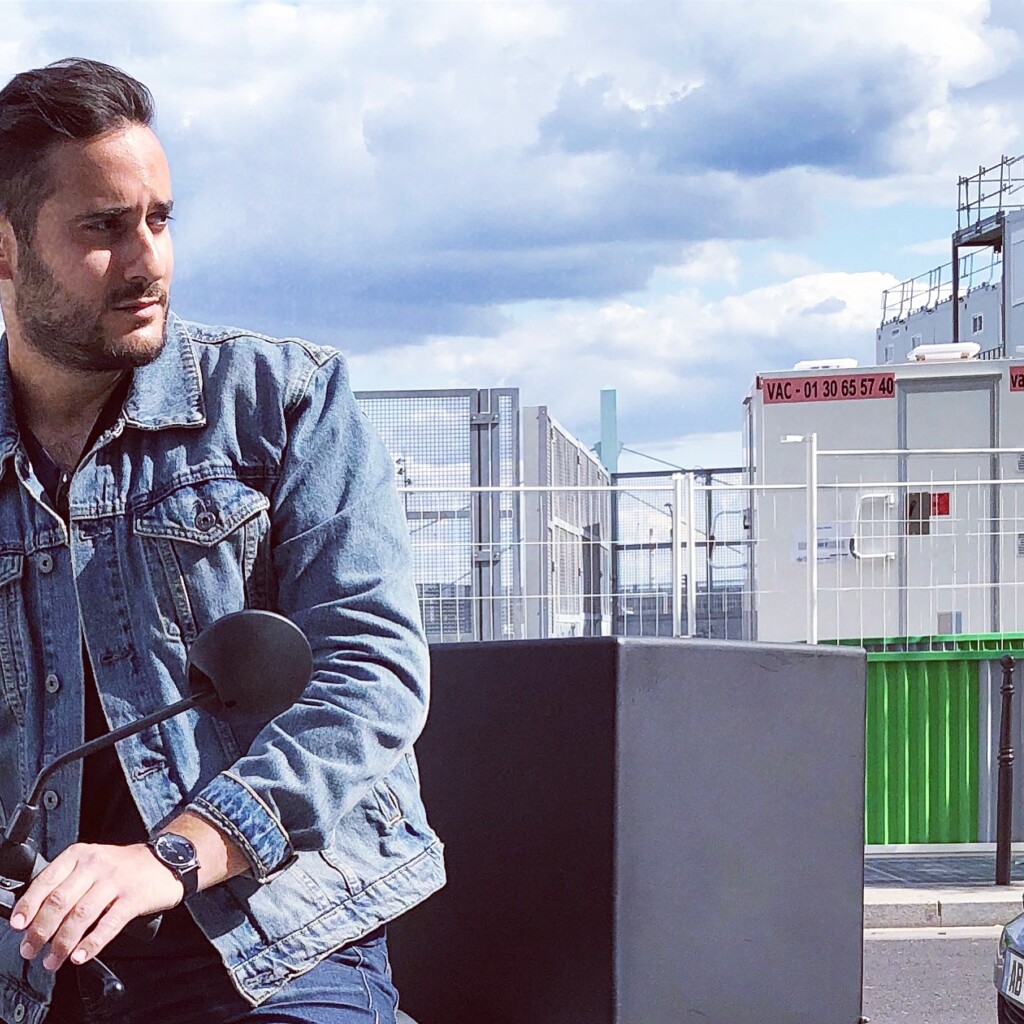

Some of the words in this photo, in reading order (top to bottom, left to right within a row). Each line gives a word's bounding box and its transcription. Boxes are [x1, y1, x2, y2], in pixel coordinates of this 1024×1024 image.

[767, 382, 792, 400] VAC
[804, 381, 818, 399] 01
[823, 380, 838, 397] 30
[841, 379, 857, 396] 65
[860, 378, 875, 395] 57
[879, 377, 894, 394] 40
